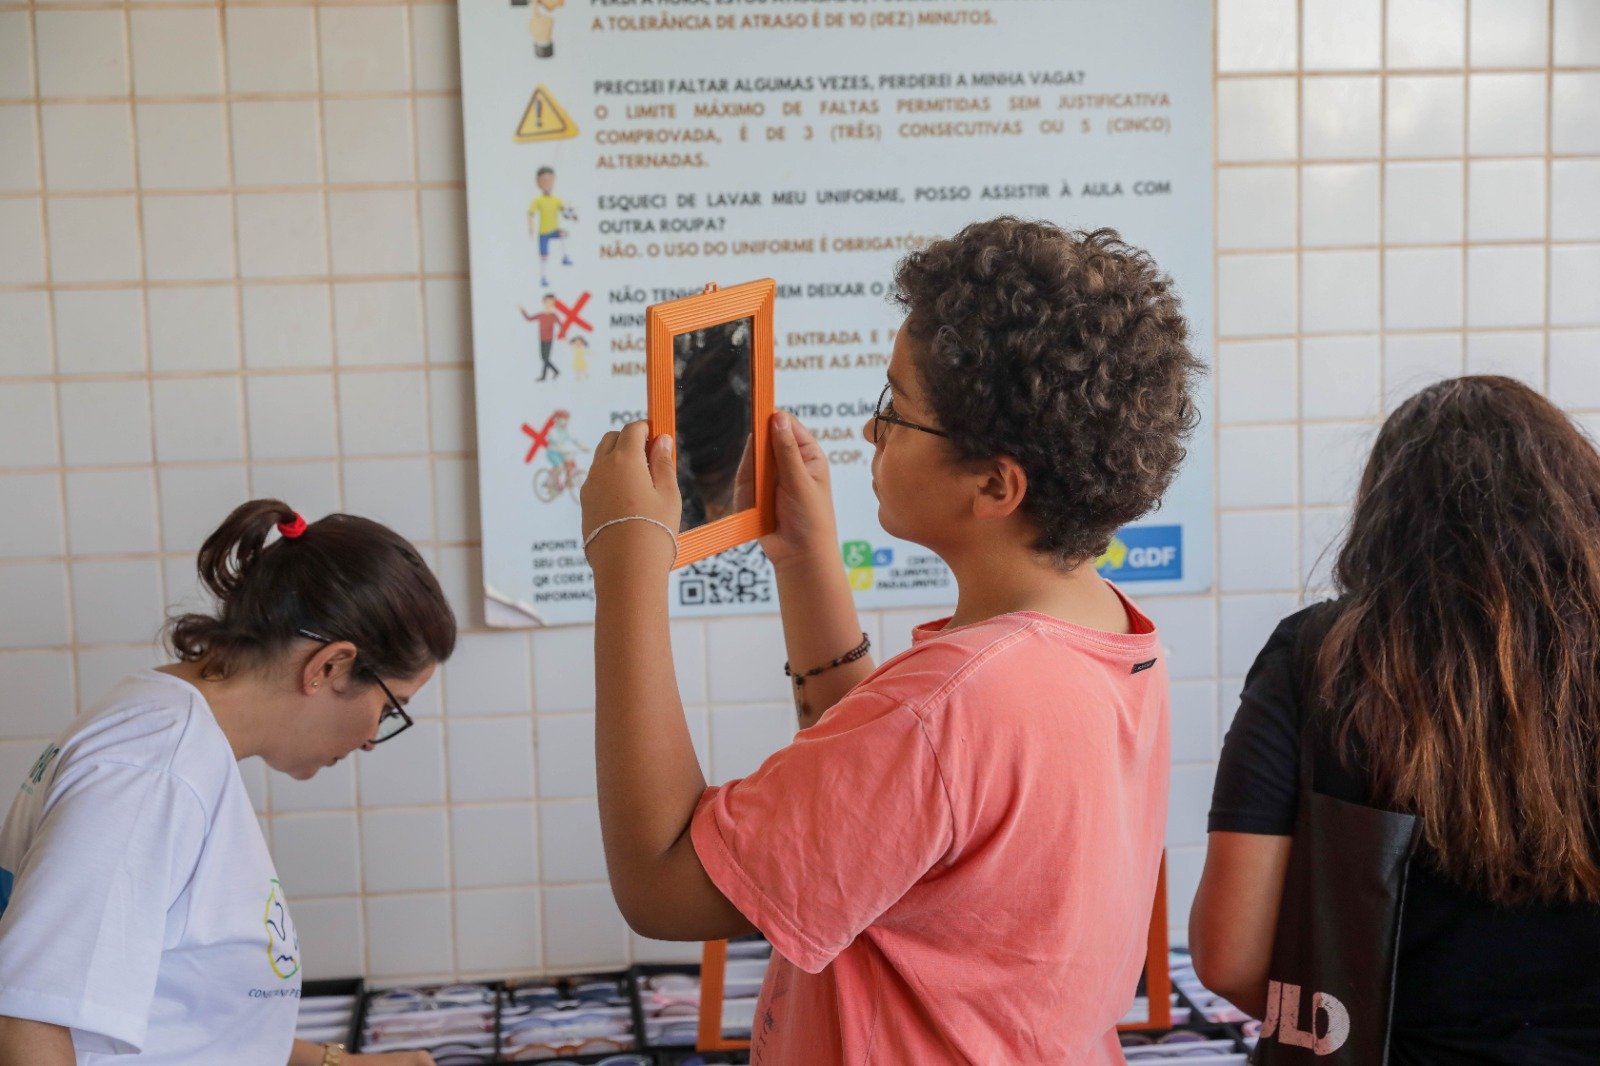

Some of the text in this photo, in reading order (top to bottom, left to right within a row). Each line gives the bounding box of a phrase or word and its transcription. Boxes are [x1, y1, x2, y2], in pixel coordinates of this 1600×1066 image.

[591, 9, 997, 31] A TOLERÂNCIA DE ATRASO É DE 10 (DEZ) MINUTOS.
[593, 70, 1085, 96] PRECISEI FALTAR ALGUMAS VEZES, PERDEREI A MINHA VAGA?
[593, 93, 1170, 120] O LIMITE MÁXIMO DE FALTAS PERMITIDAS SEM JUSTIFICATIVA
[739, 124, 748, 142] É
[766, 126, 785, 141] DE
[804, 126, 814, 140] 3
[831, 120, 881, 141] (TRÊS)
[898, 121, 1022, 138] CONSECUTIVAS
[1039, 120, 1064, 134] OU
[1082, 119, 1090, 133] 5
[1107, 117, 1170, 133] (CINCO)
[595, 152, 707, 169] ALTERNADAS.
[597, 180, 1171, 213] ESQUECI DE LAVAR MEU UNIFORME, POSSO ASSISTIR À AULA COM
[599, 216, 726, 235] OUTRA ROUPA?
[599, 240, 642, 259] NÃO.
[647, 243, 660, 258] O
[664, 242, 699, 257] USO
[703, 241, 728, 256] DO
[732, 239, 814, 255] UNIFORME
[819, 234, 829, 254] É
[609, 285, 646, 302] NÃO
[807, 282, 864, 298] DEIXAR
[870, 281, 884, 296] O
[787, 330, 861, 346] ENTRADA
[870, 329, 878, 344] E
[831, 352, 851, 369] AS
[1128, 546, 1176, 569] GDF
